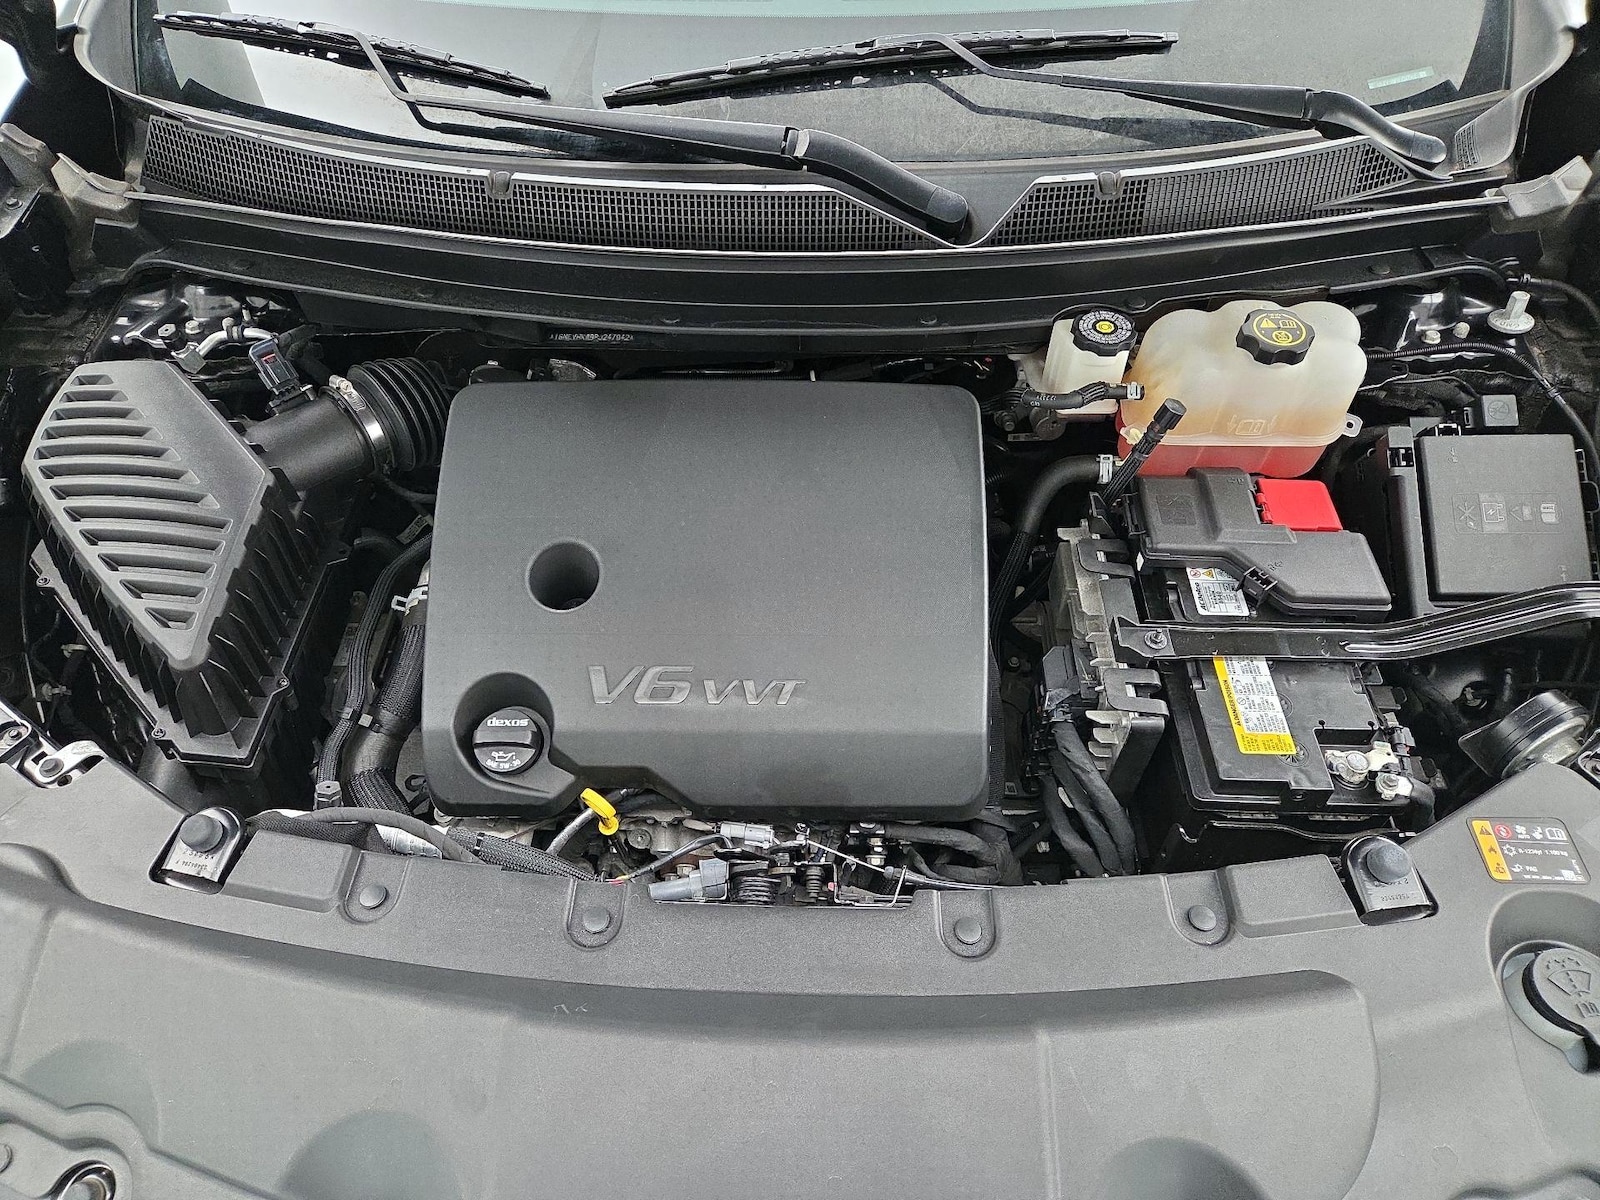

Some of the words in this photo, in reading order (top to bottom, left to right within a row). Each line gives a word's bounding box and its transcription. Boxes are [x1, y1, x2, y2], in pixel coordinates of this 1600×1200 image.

[588, 665, 695, 704] V6
[703, 679, 807, 705] VVT
[487, 717, 530, 727] dexos
